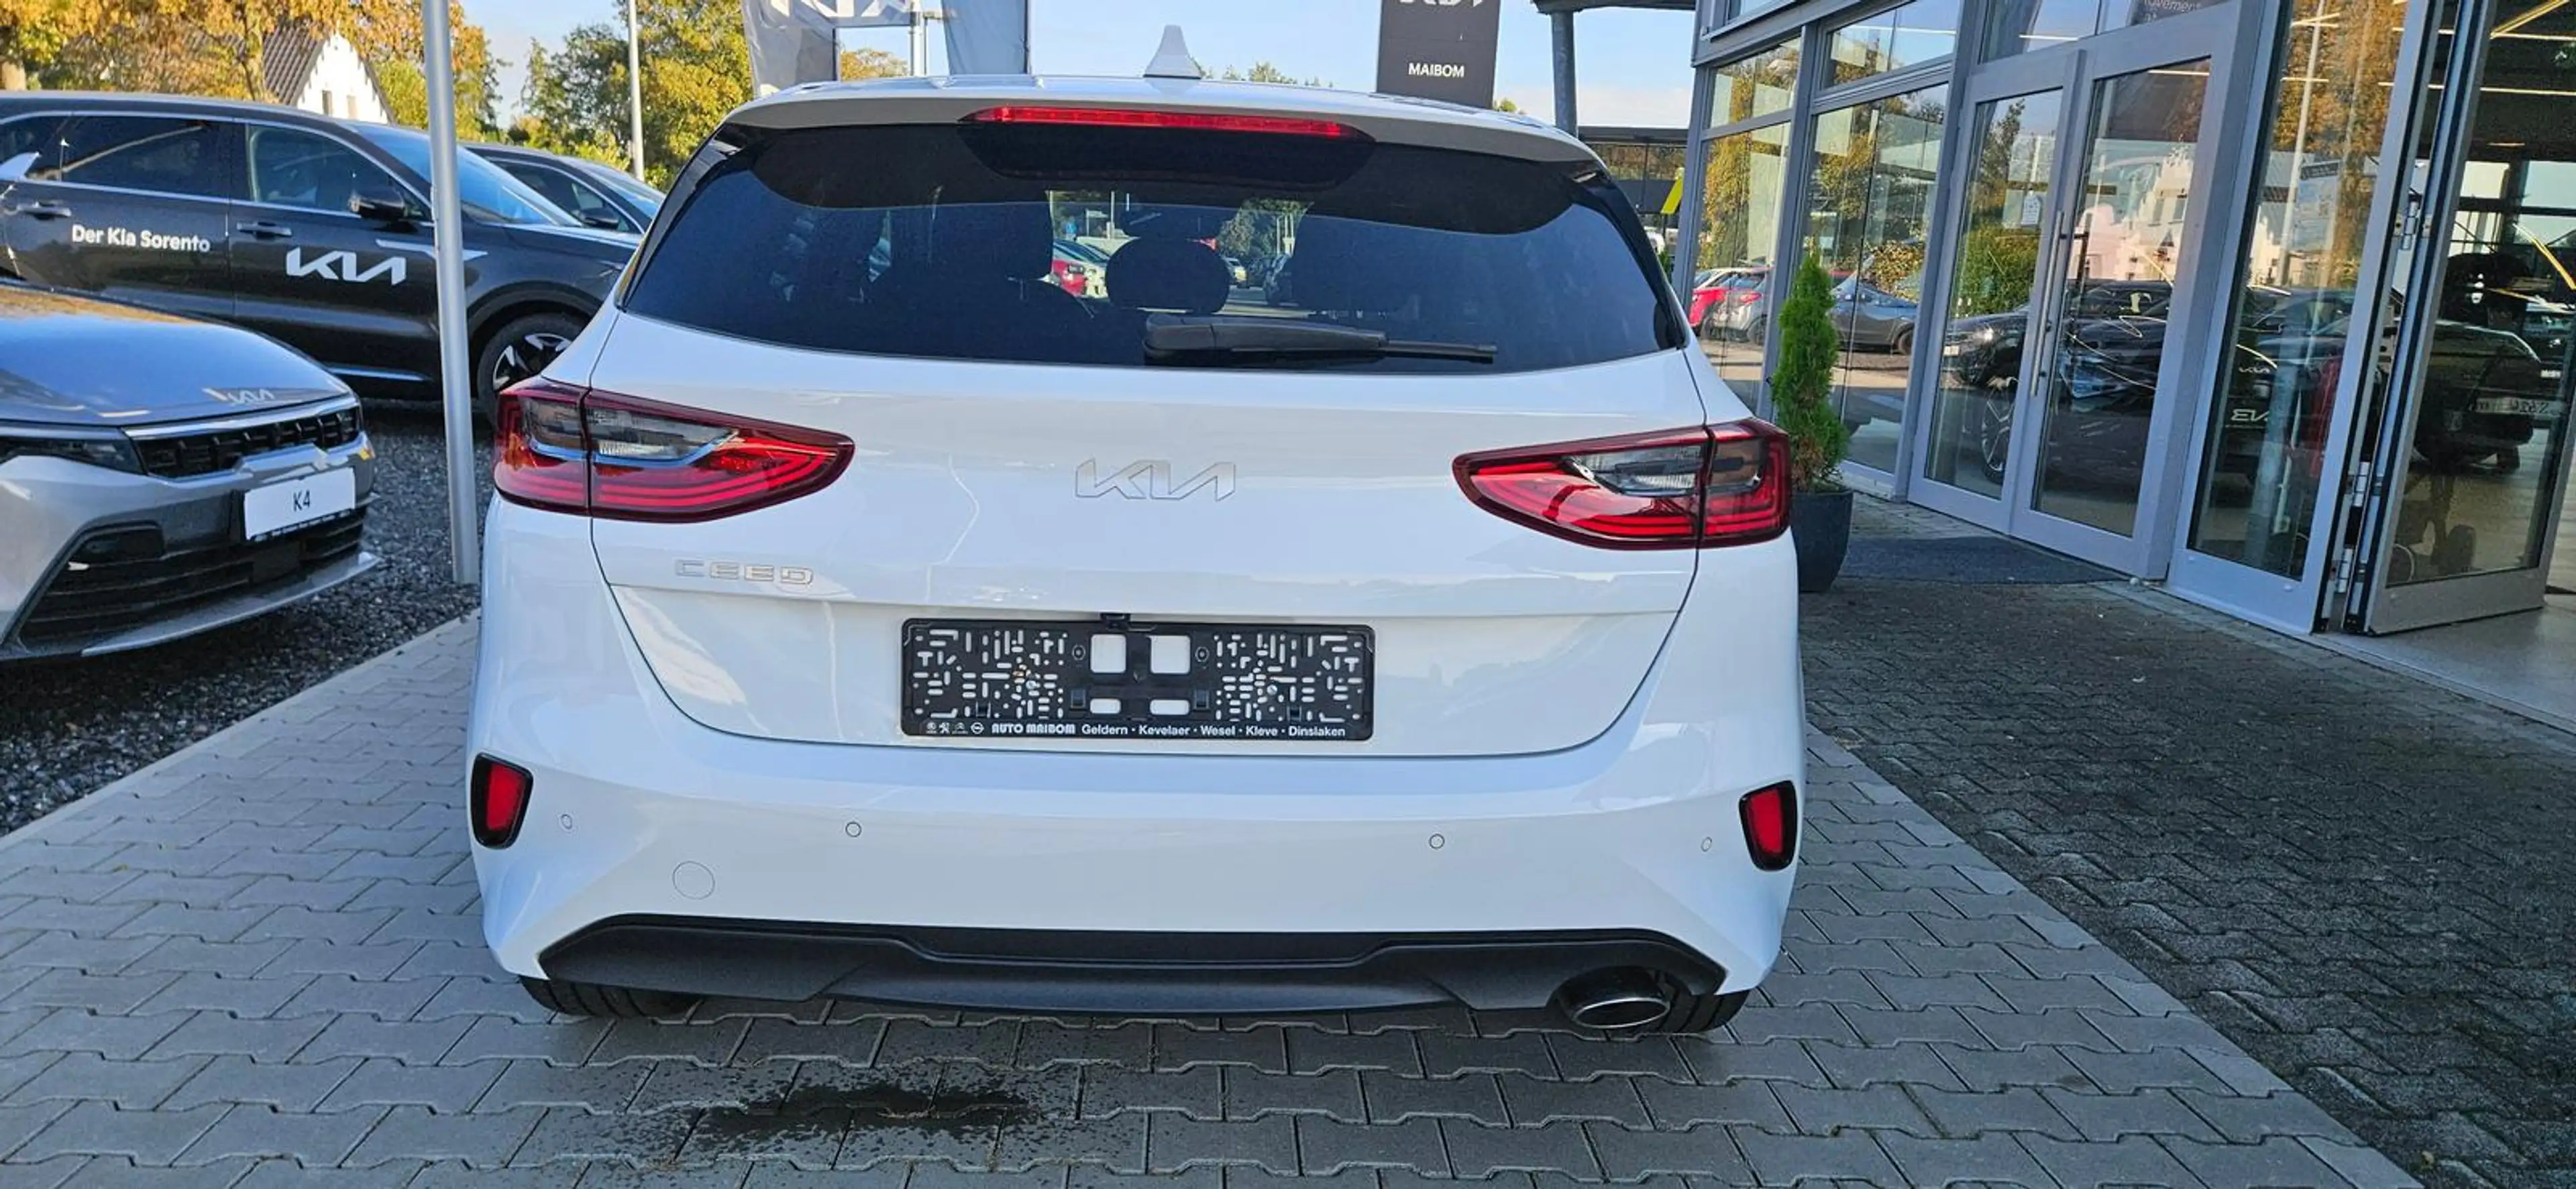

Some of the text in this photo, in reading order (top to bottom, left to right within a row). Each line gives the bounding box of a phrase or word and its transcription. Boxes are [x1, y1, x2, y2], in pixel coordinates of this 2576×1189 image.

[1409, 62, 1465, 78] MAIBOM
[72, 224, 210, 253] Der Kia Sorento
[286, 247, 407, 285] KIA
[1075, 457, 1236, 502] KIA
[292, 490, 311, 512] K4
[675, 559, 814, 585] CEED
[991, 723, 1346, 736] AUTO MAIBOM Geldern Kevelaer Wesel Kleve Dinslaken
